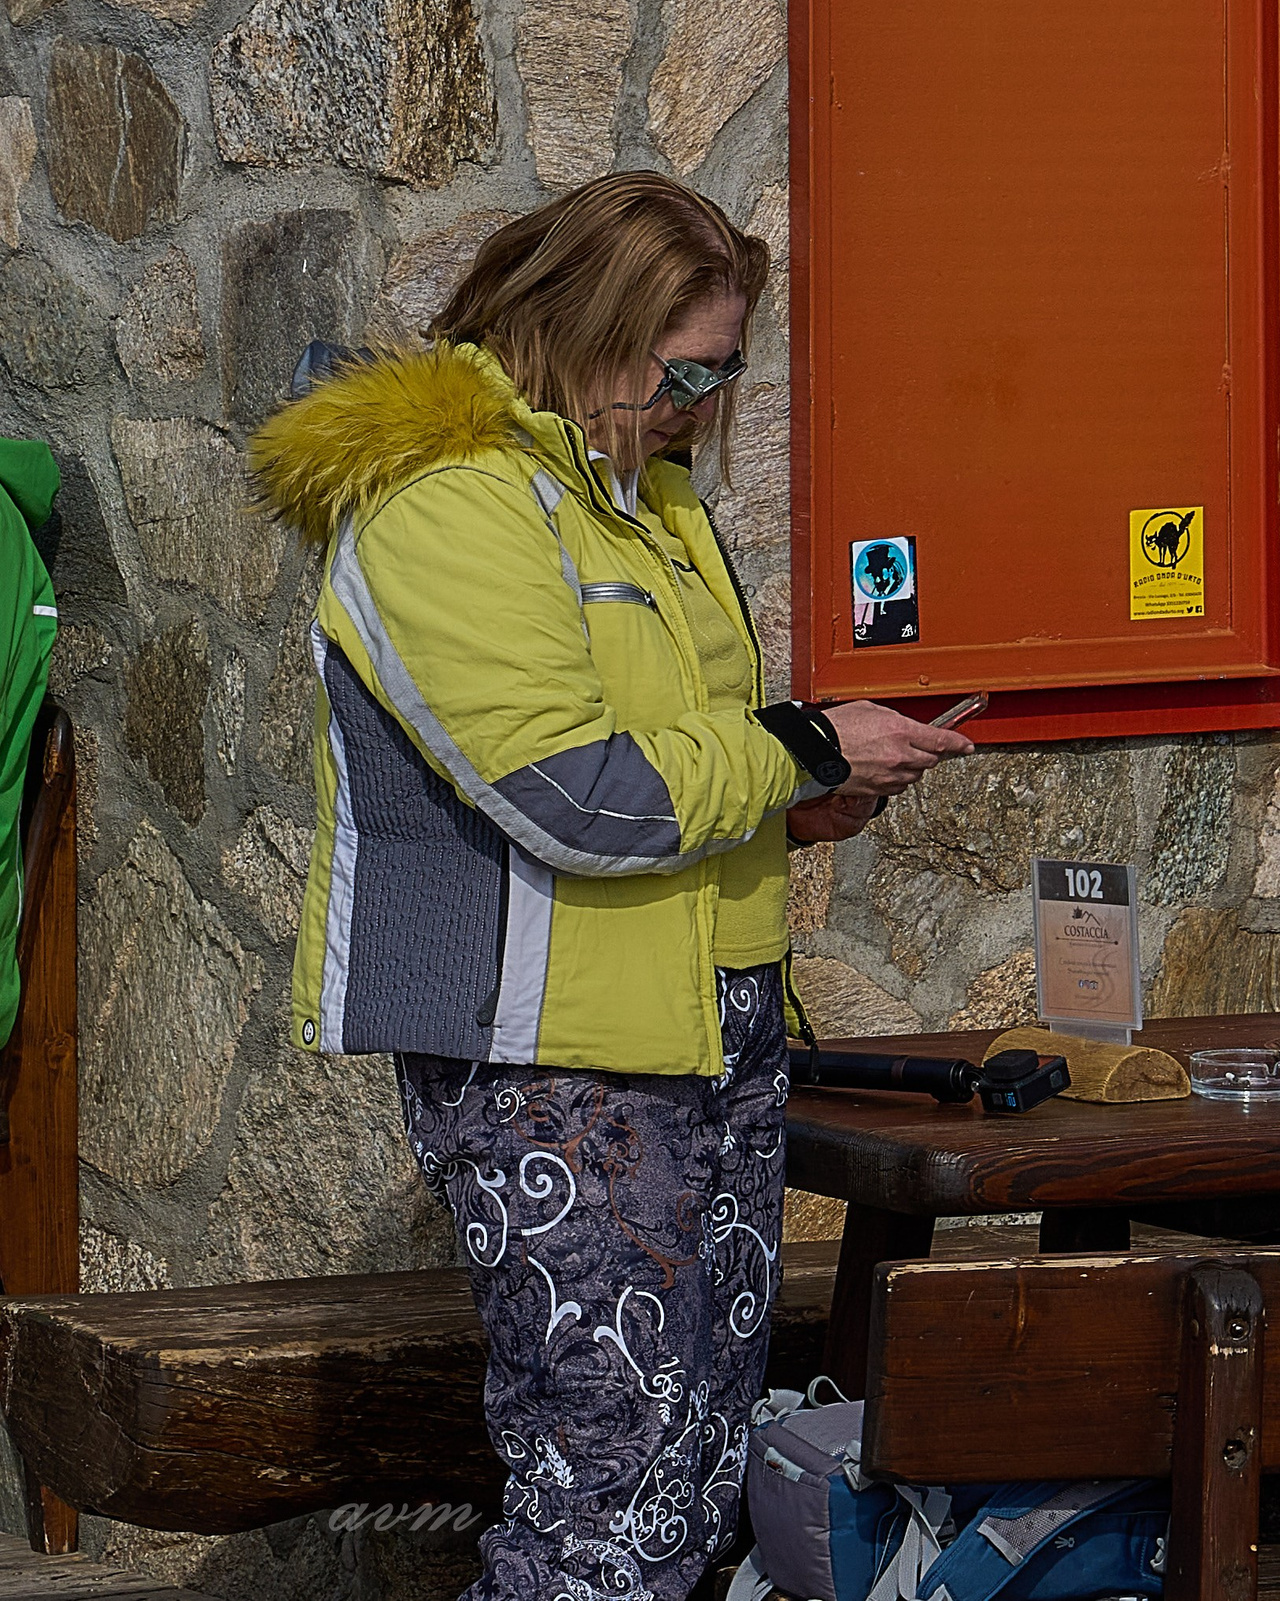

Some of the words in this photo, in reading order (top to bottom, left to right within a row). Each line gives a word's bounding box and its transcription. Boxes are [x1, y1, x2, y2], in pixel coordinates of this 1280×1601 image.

[1134, 575, 1154, 587] RADIO
[1157, 572, 1175, 580] ONDA
[1064, 868, 1104, 899] 102
[1064, 924, 1109, 940] COSTACCIA
